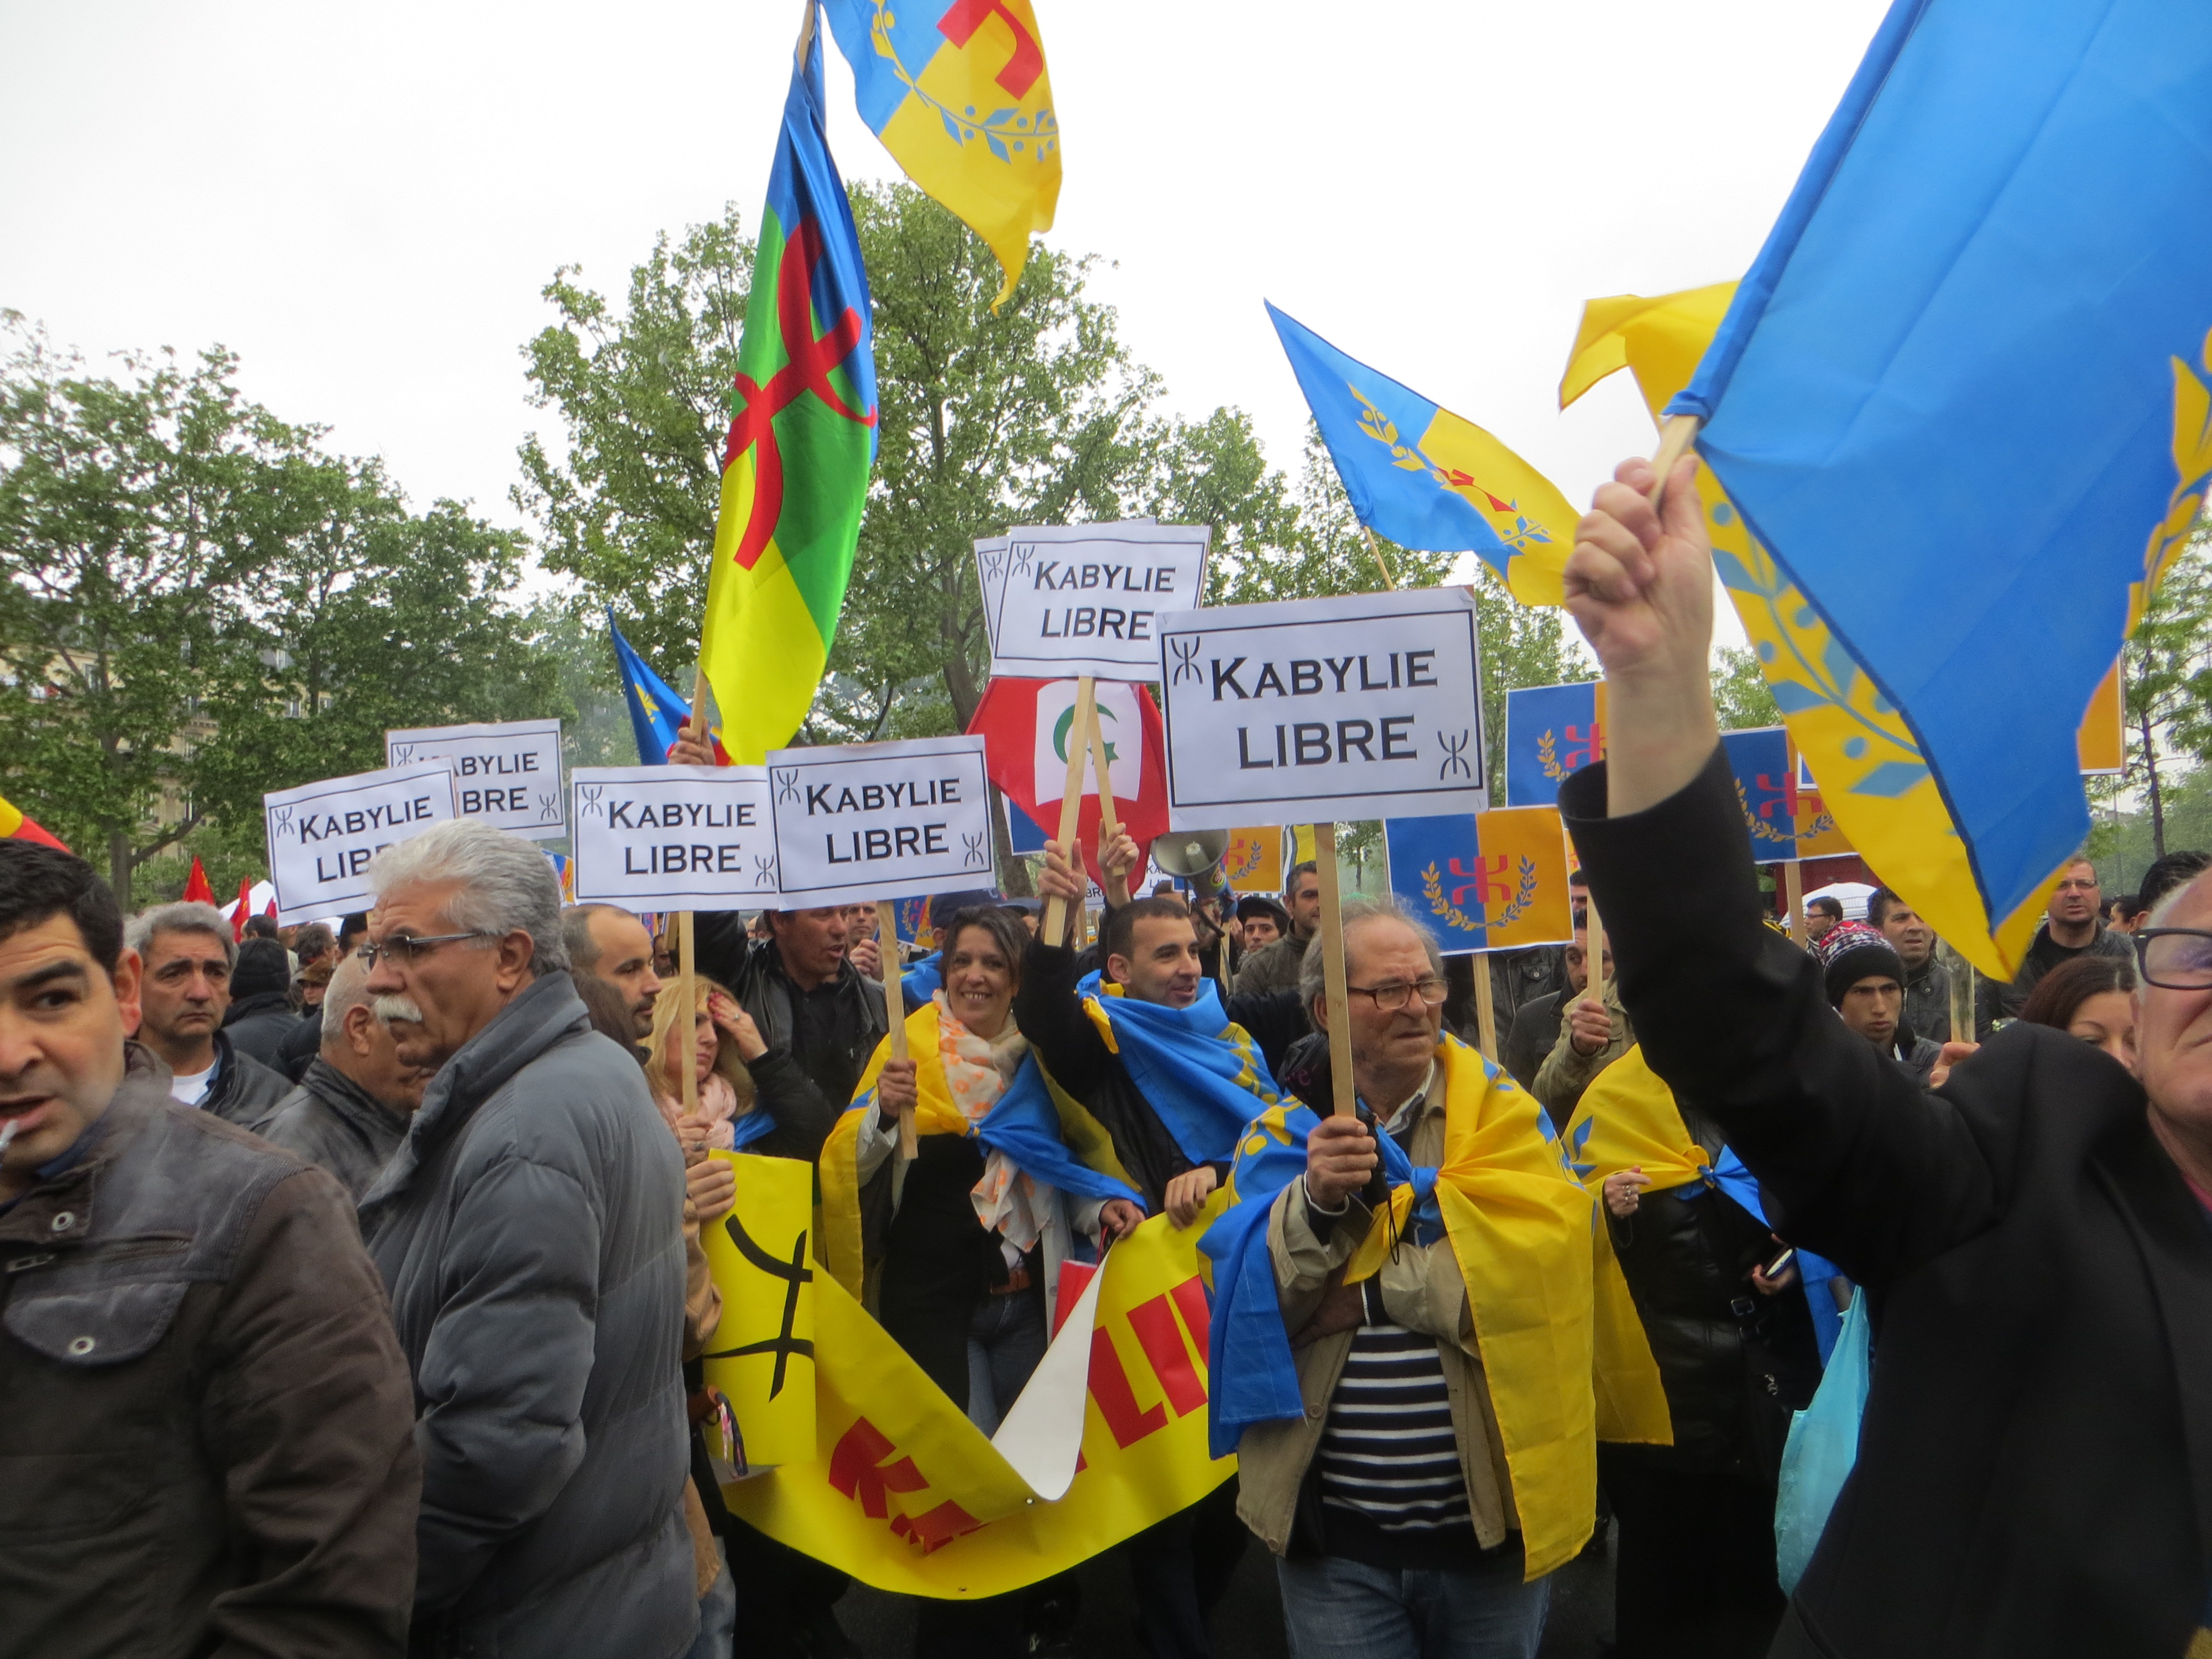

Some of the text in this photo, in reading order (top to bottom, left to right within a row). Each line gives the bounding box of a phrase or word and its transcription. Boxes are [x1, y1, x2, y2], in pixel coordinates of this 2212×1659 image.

[1034, 560, 1176, 593] KABYLIE
[1040, 607, 1155, 640] LIBRE
[1210, 648, 1438, 701] KABYLIE
[1237, 714, 1418, 770] LIBRE
[419, 752, 539, 777] BYLIE
[457, 786, 529, 815] BRE
[805, 777, 962, 816] KABYLIE
[299, 795, 434, 844] KABYLIE
[608, 800, 757, 830] KABYLIE
[624, 844, 742, 875] LIBRE
[826, 822, 950, 864] LIBRE
[316, 843, 392, 884] LIB
